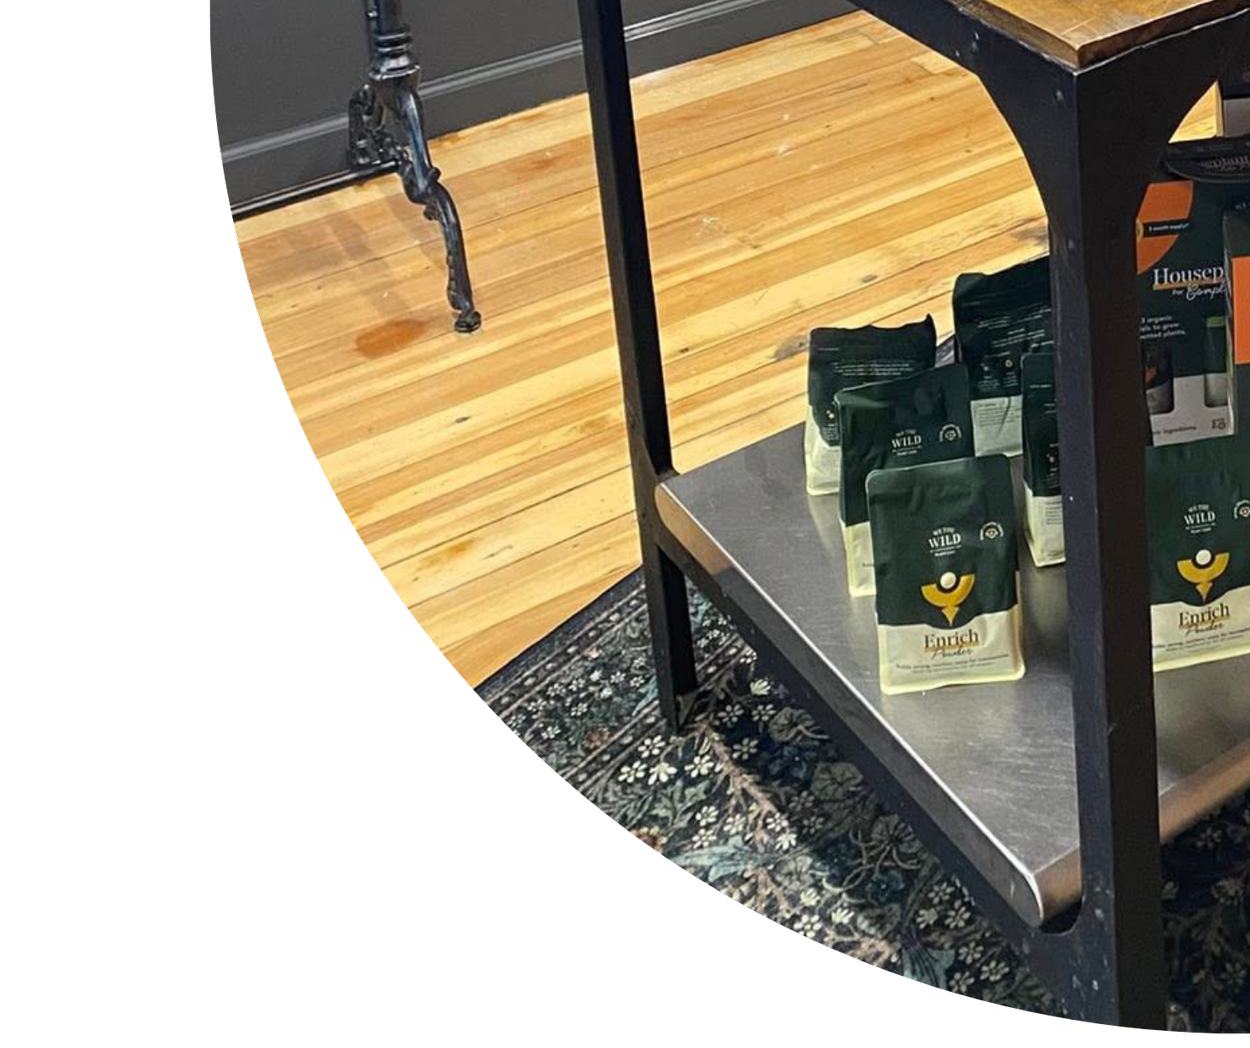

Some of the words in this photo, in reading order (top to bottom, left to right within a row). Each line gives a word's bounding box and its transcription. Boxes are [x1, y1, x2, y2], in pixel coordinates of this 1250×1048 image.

[1147, 315, 1172, 323] organic
[892, 435, 922, 448] WILD
[1184, 511, 1216, 525] WILD
[928, 533, 961, 548] WILD
[1179, 603, 1230, 626] Enrich
[924, 629, 979, 649] Enrich
